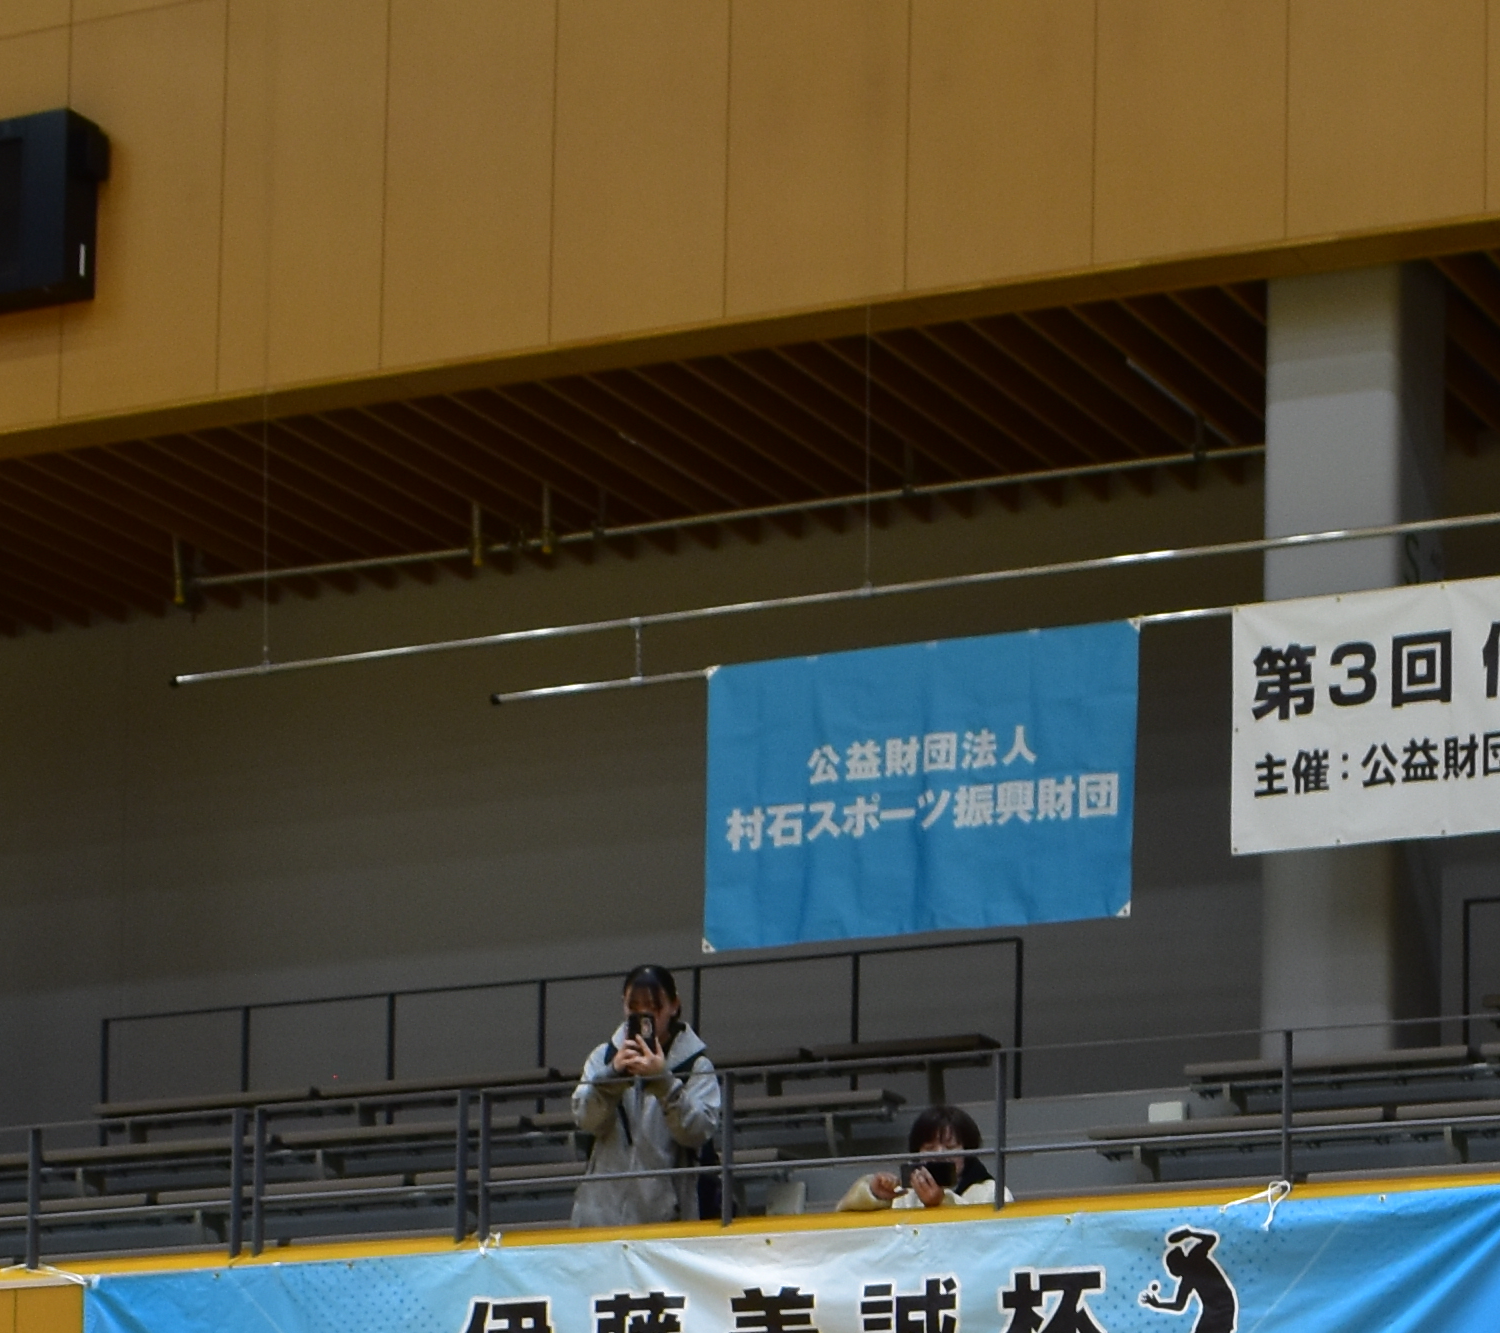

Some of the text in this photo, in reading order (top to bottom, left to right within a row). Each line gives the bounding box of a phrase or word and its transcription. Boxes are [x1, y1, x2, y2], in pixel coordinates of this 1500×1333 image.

[1250, 630, 1454, 721] 第3回
[806, 724, 1037, 785] 公益財団法人
[726, 772, 1120, 852] 村石スポーツ振興財団
